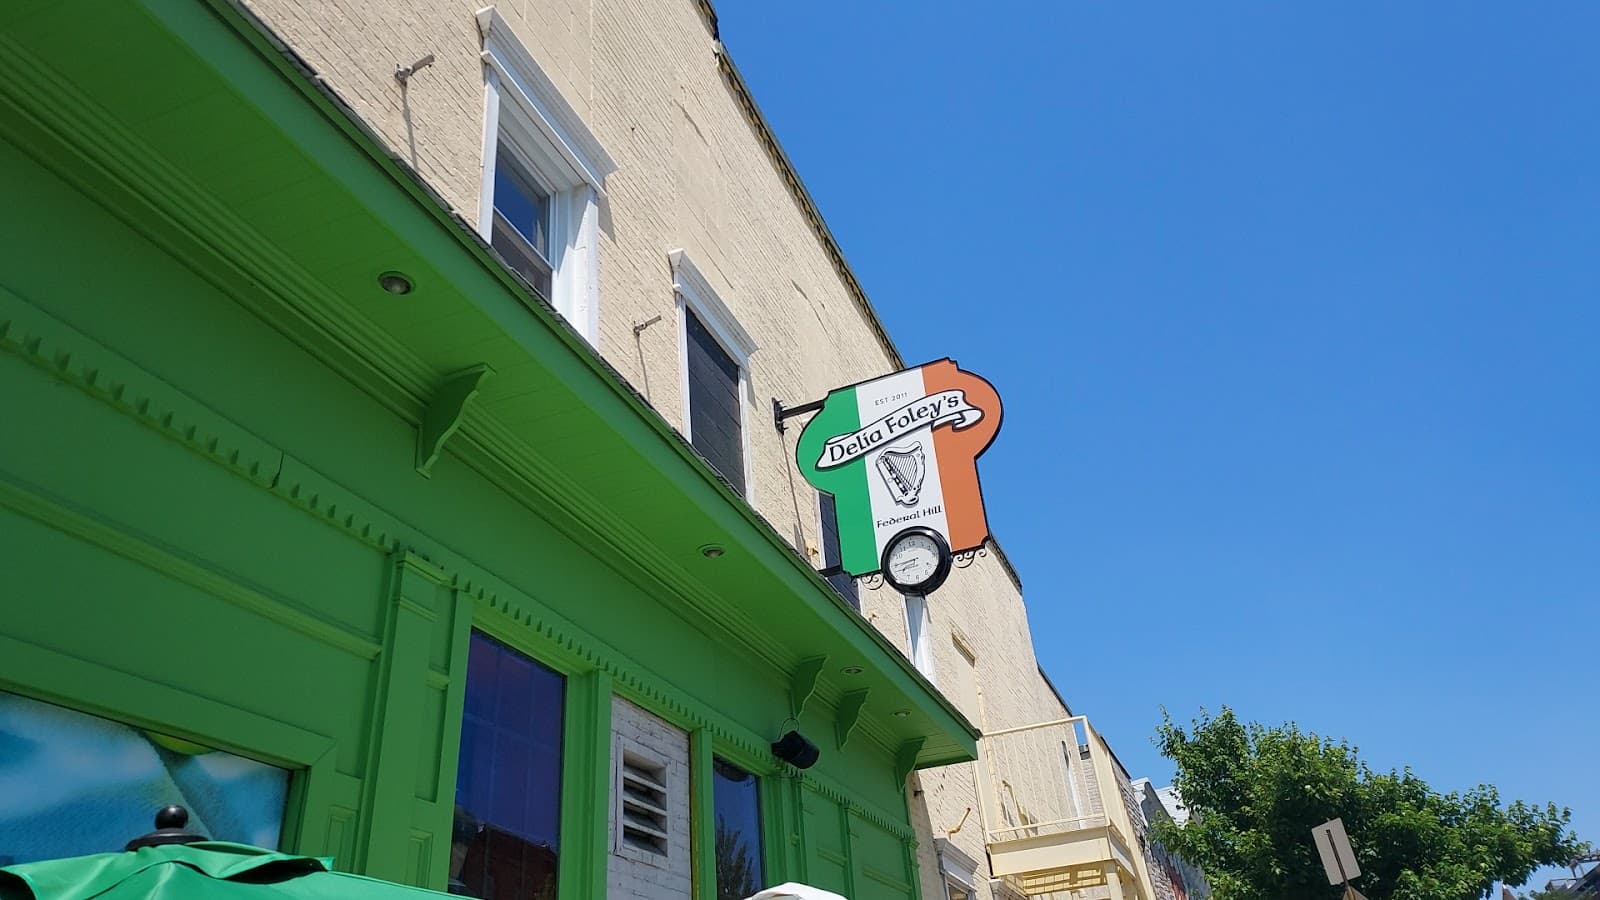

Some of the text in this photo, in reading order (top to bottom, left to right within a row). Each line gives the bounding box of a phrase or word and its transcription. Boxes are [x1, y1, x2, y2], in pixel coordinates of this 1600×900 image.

[829, 395, 960, 463] Delia Foley's
[877, 505, 942, 528] Federal Hill
